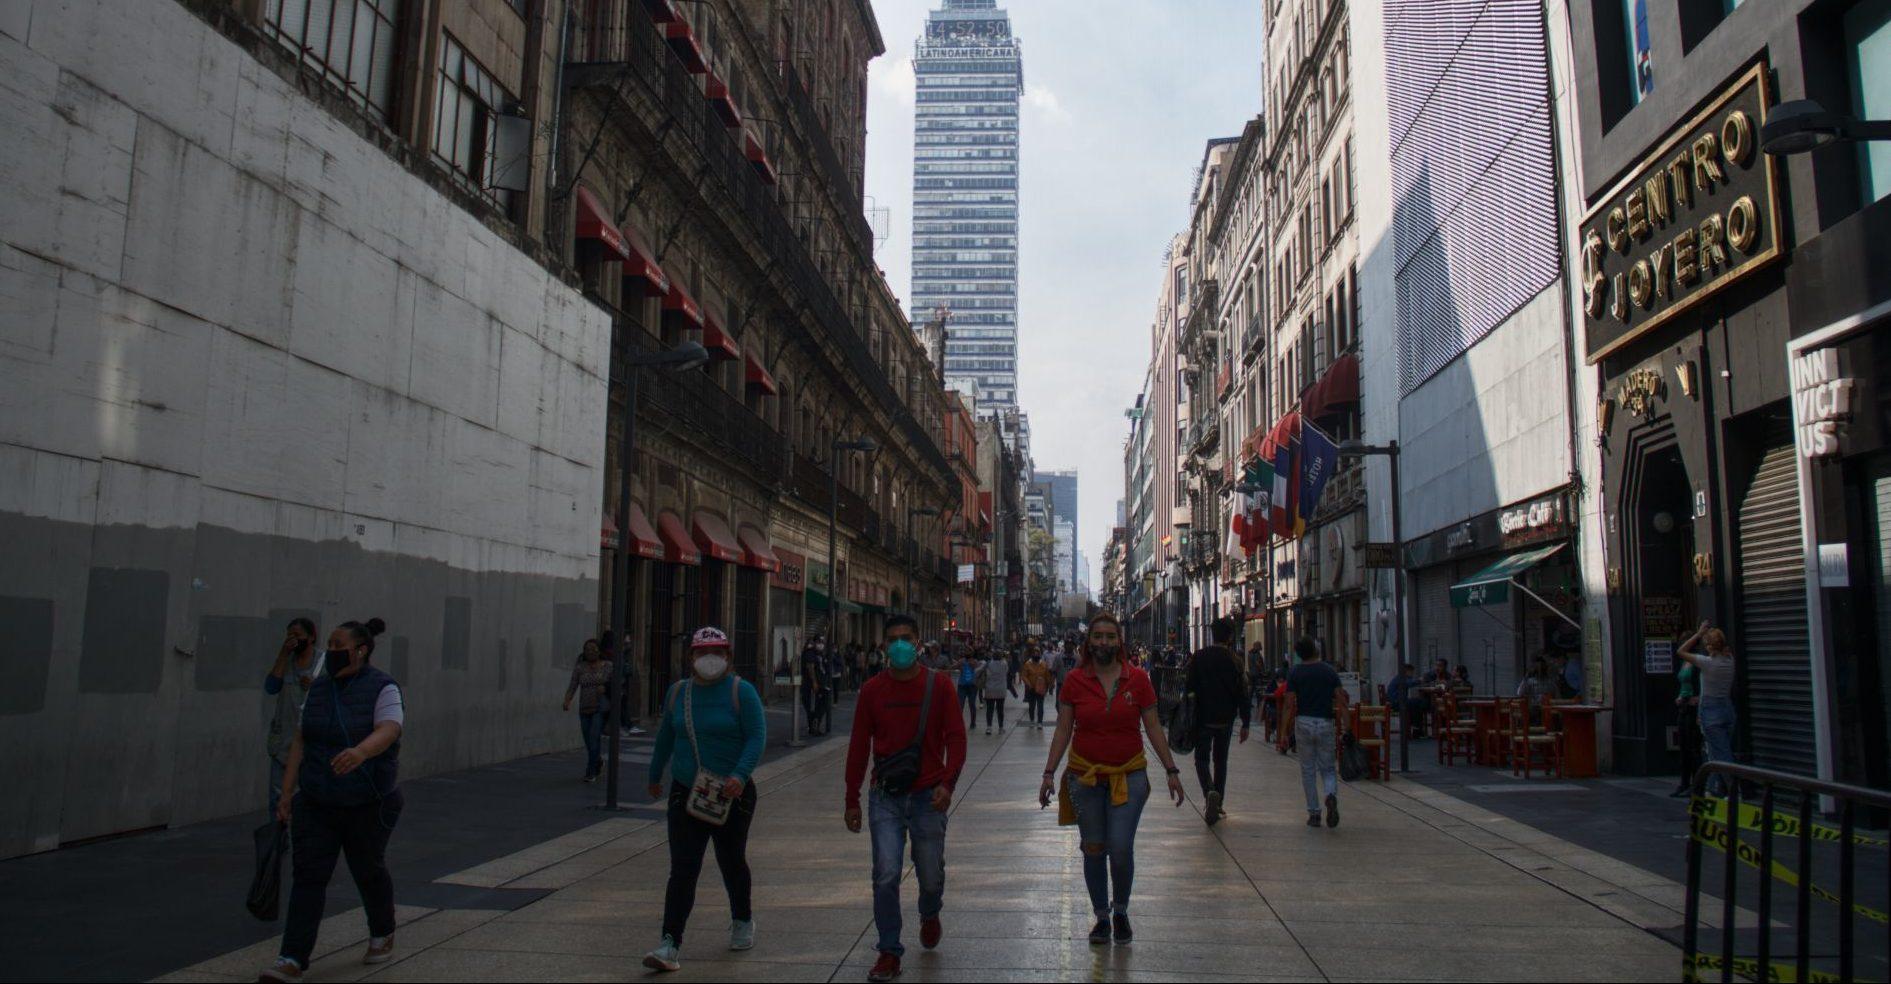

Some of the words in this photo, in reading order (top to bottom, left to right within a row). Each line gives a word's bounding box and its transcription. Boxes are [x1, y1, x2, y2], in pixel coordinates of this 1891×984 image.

[920, 49, 1012, 58] LATINOAMERICANA
[1607, 109, 1754, 253] CENTRO
[1611, 194, 1760, 322] JOYERO
[1618, 369, 1661, 409] MADERO
[1795, 348, 1830, 390] INN
[1797, 378, 1846, 424] VICT
[1800, 421, 1836, 458] US
[1694, 552, 1712, 585] 34
